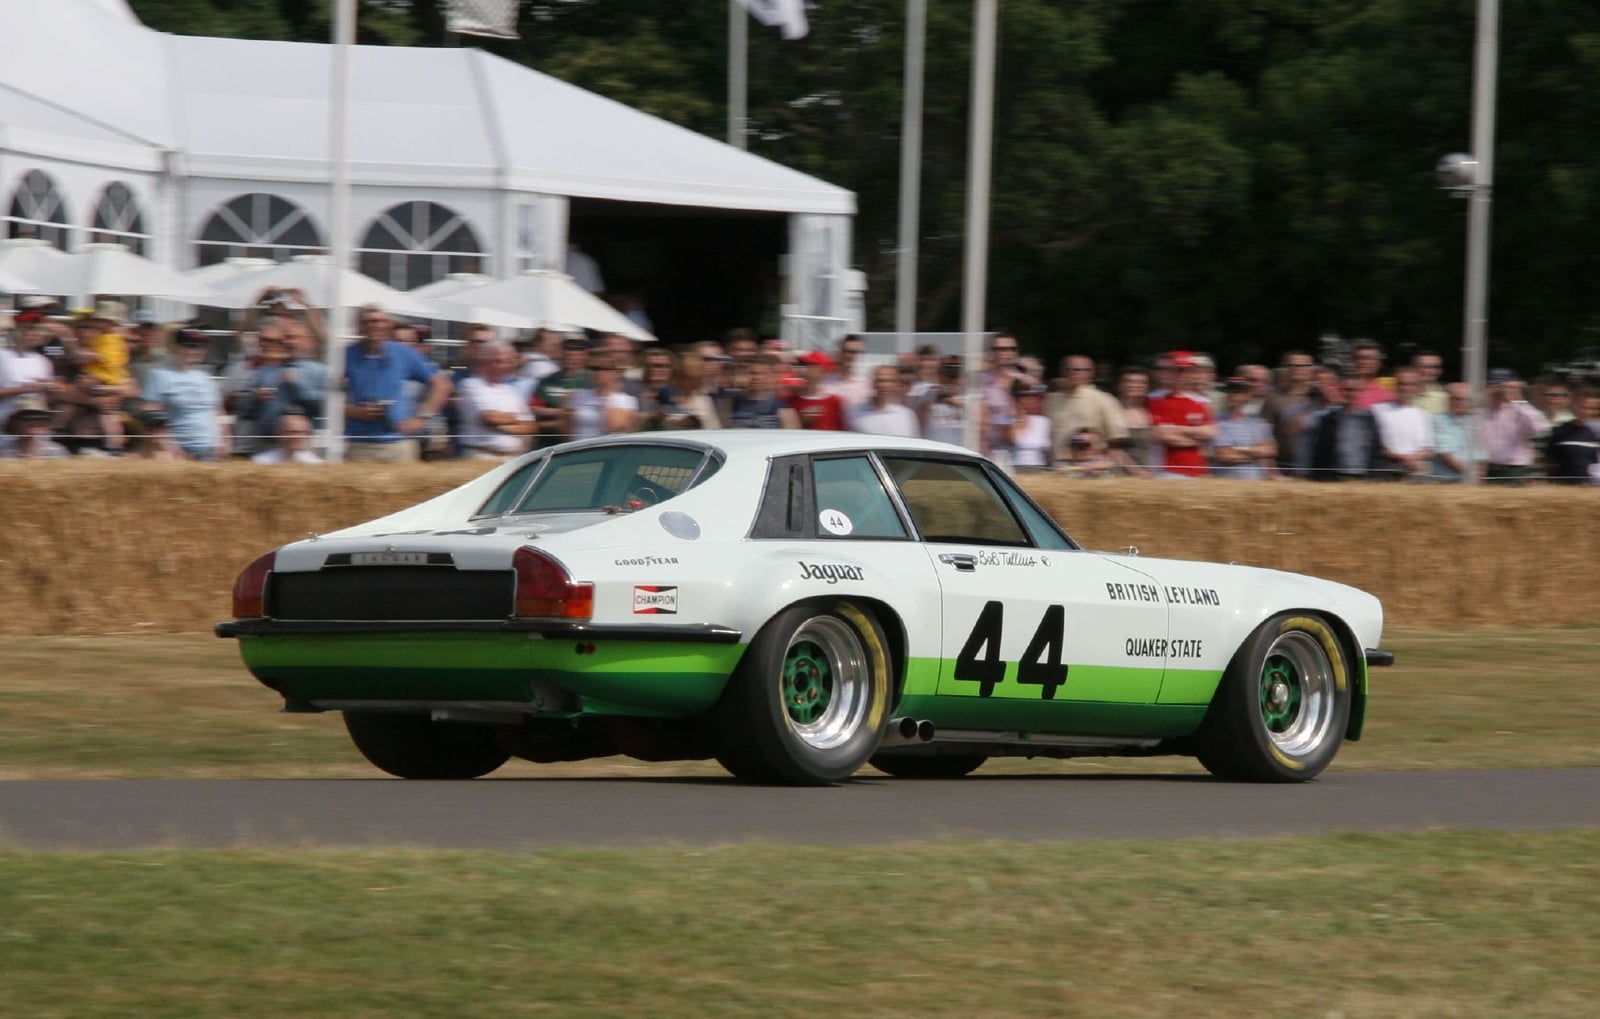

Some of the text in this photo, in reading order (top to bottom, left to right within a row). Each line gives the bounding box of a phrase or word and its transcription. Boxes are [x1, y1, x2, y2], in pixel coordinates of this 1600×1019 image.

[829, 515, 845, 529] 44
[614, 555, 679, 567] GOODYEAR
[999, 552, 1038, 568] Tullius
[798, 561, 864, 584] Jaguar
[635, 594, 676, 605] CHAMPION
[1105, 582, 1221, 606] BRITISH LEYLAND
[954, 600, 1069, 700] 44
[1125, 638, 1202, 658] QUAKER STATE
